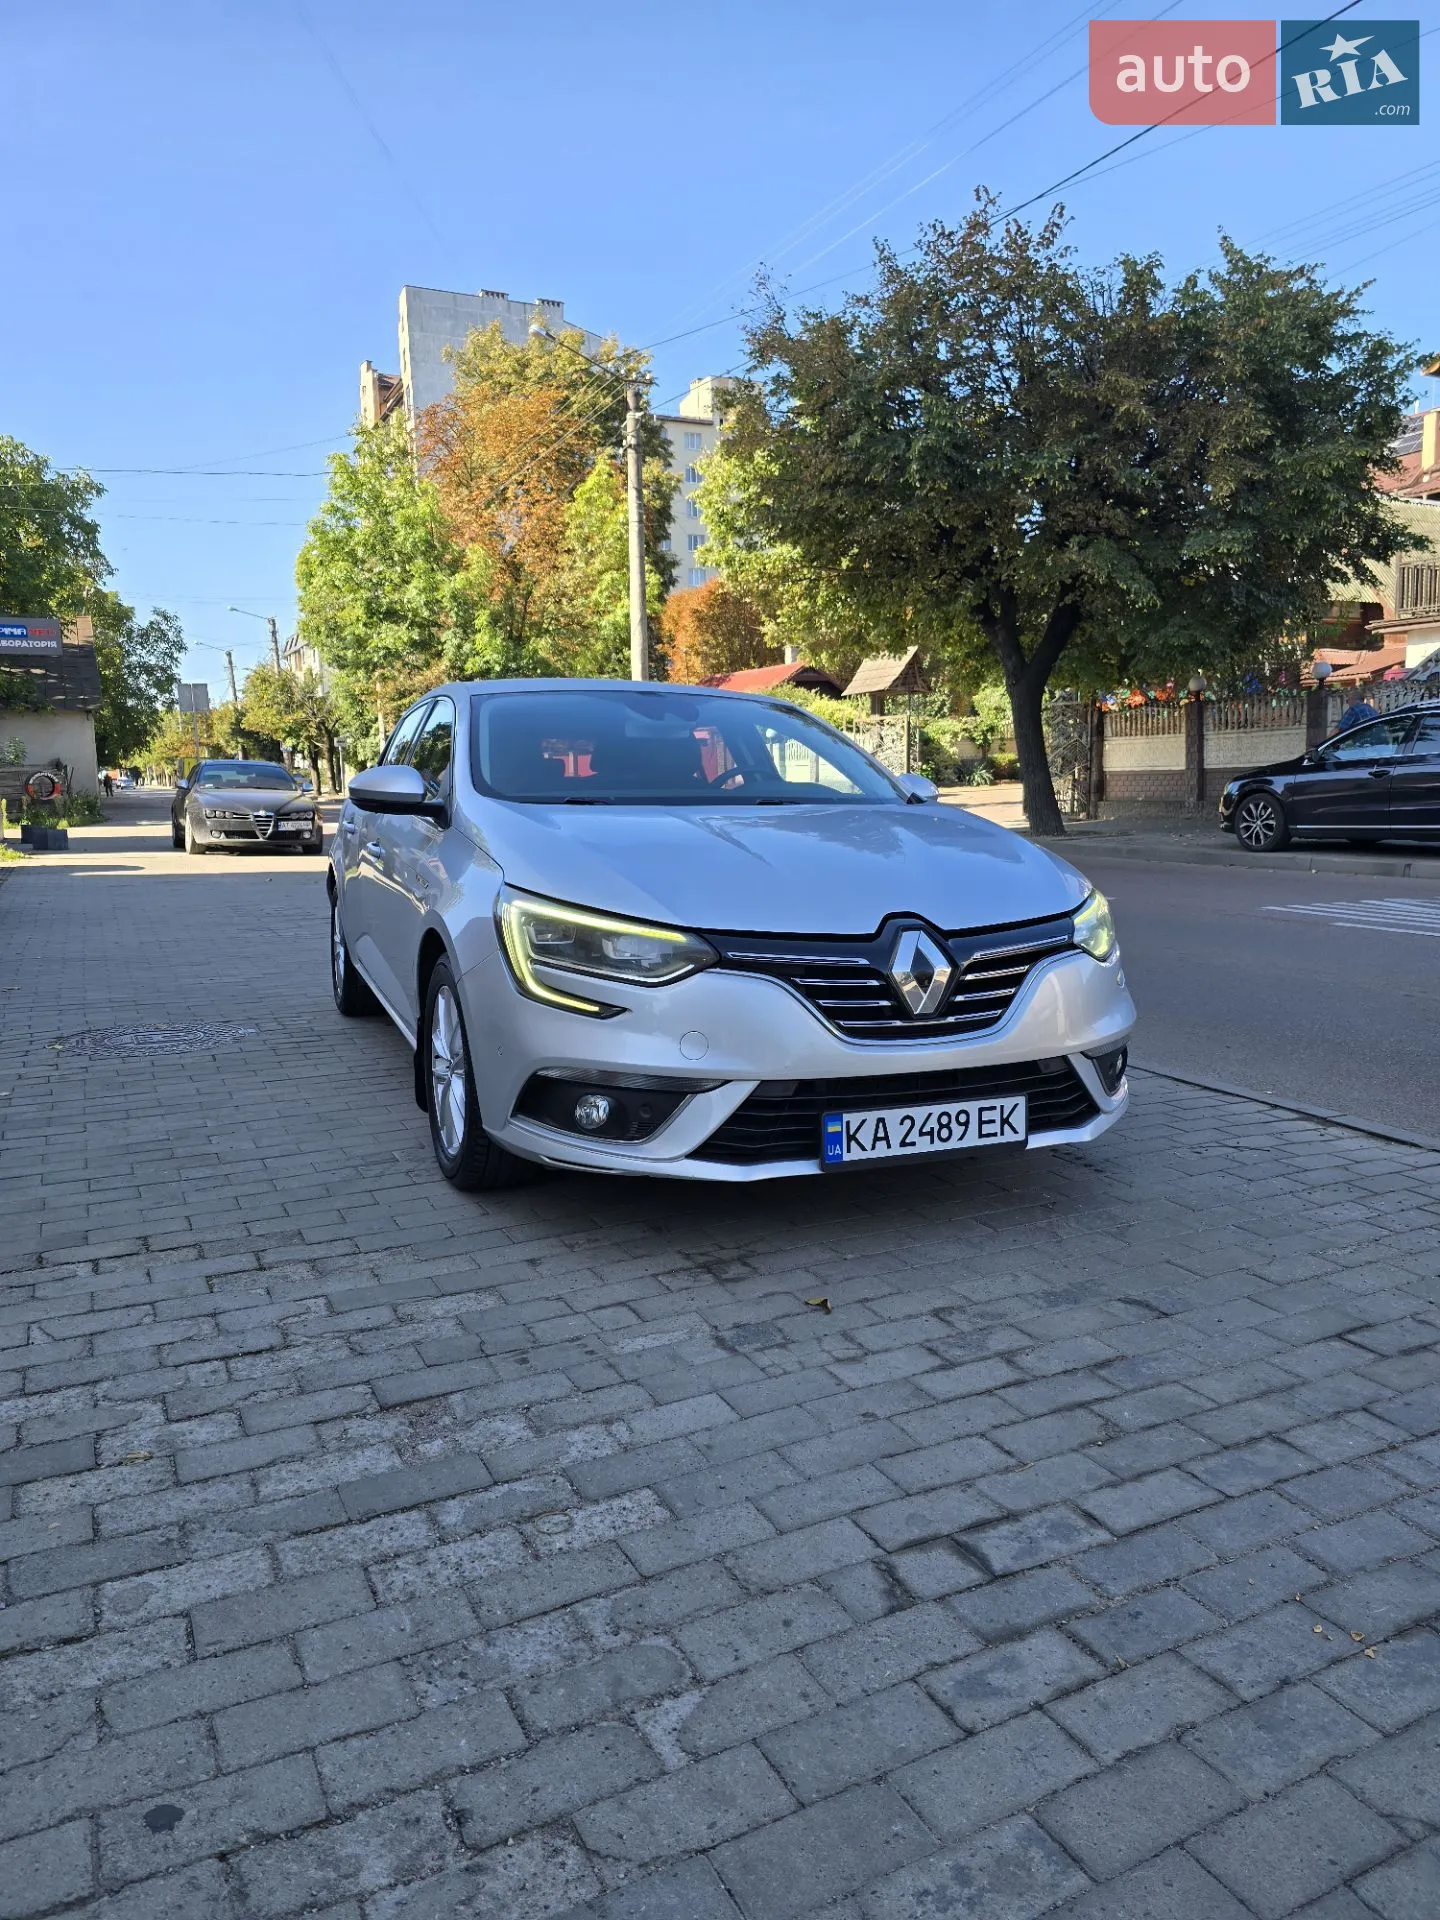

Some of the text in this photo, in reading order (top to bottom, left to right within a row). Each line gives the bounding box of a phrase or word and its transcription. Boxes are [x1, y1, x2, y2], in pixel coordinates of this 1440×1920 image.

[0, 640, 57, 648] БОРАТОРІЯ
[846, 1103, 1020, 1154] KA 2489 EK
[827, 1144, 842, 1156] UA
